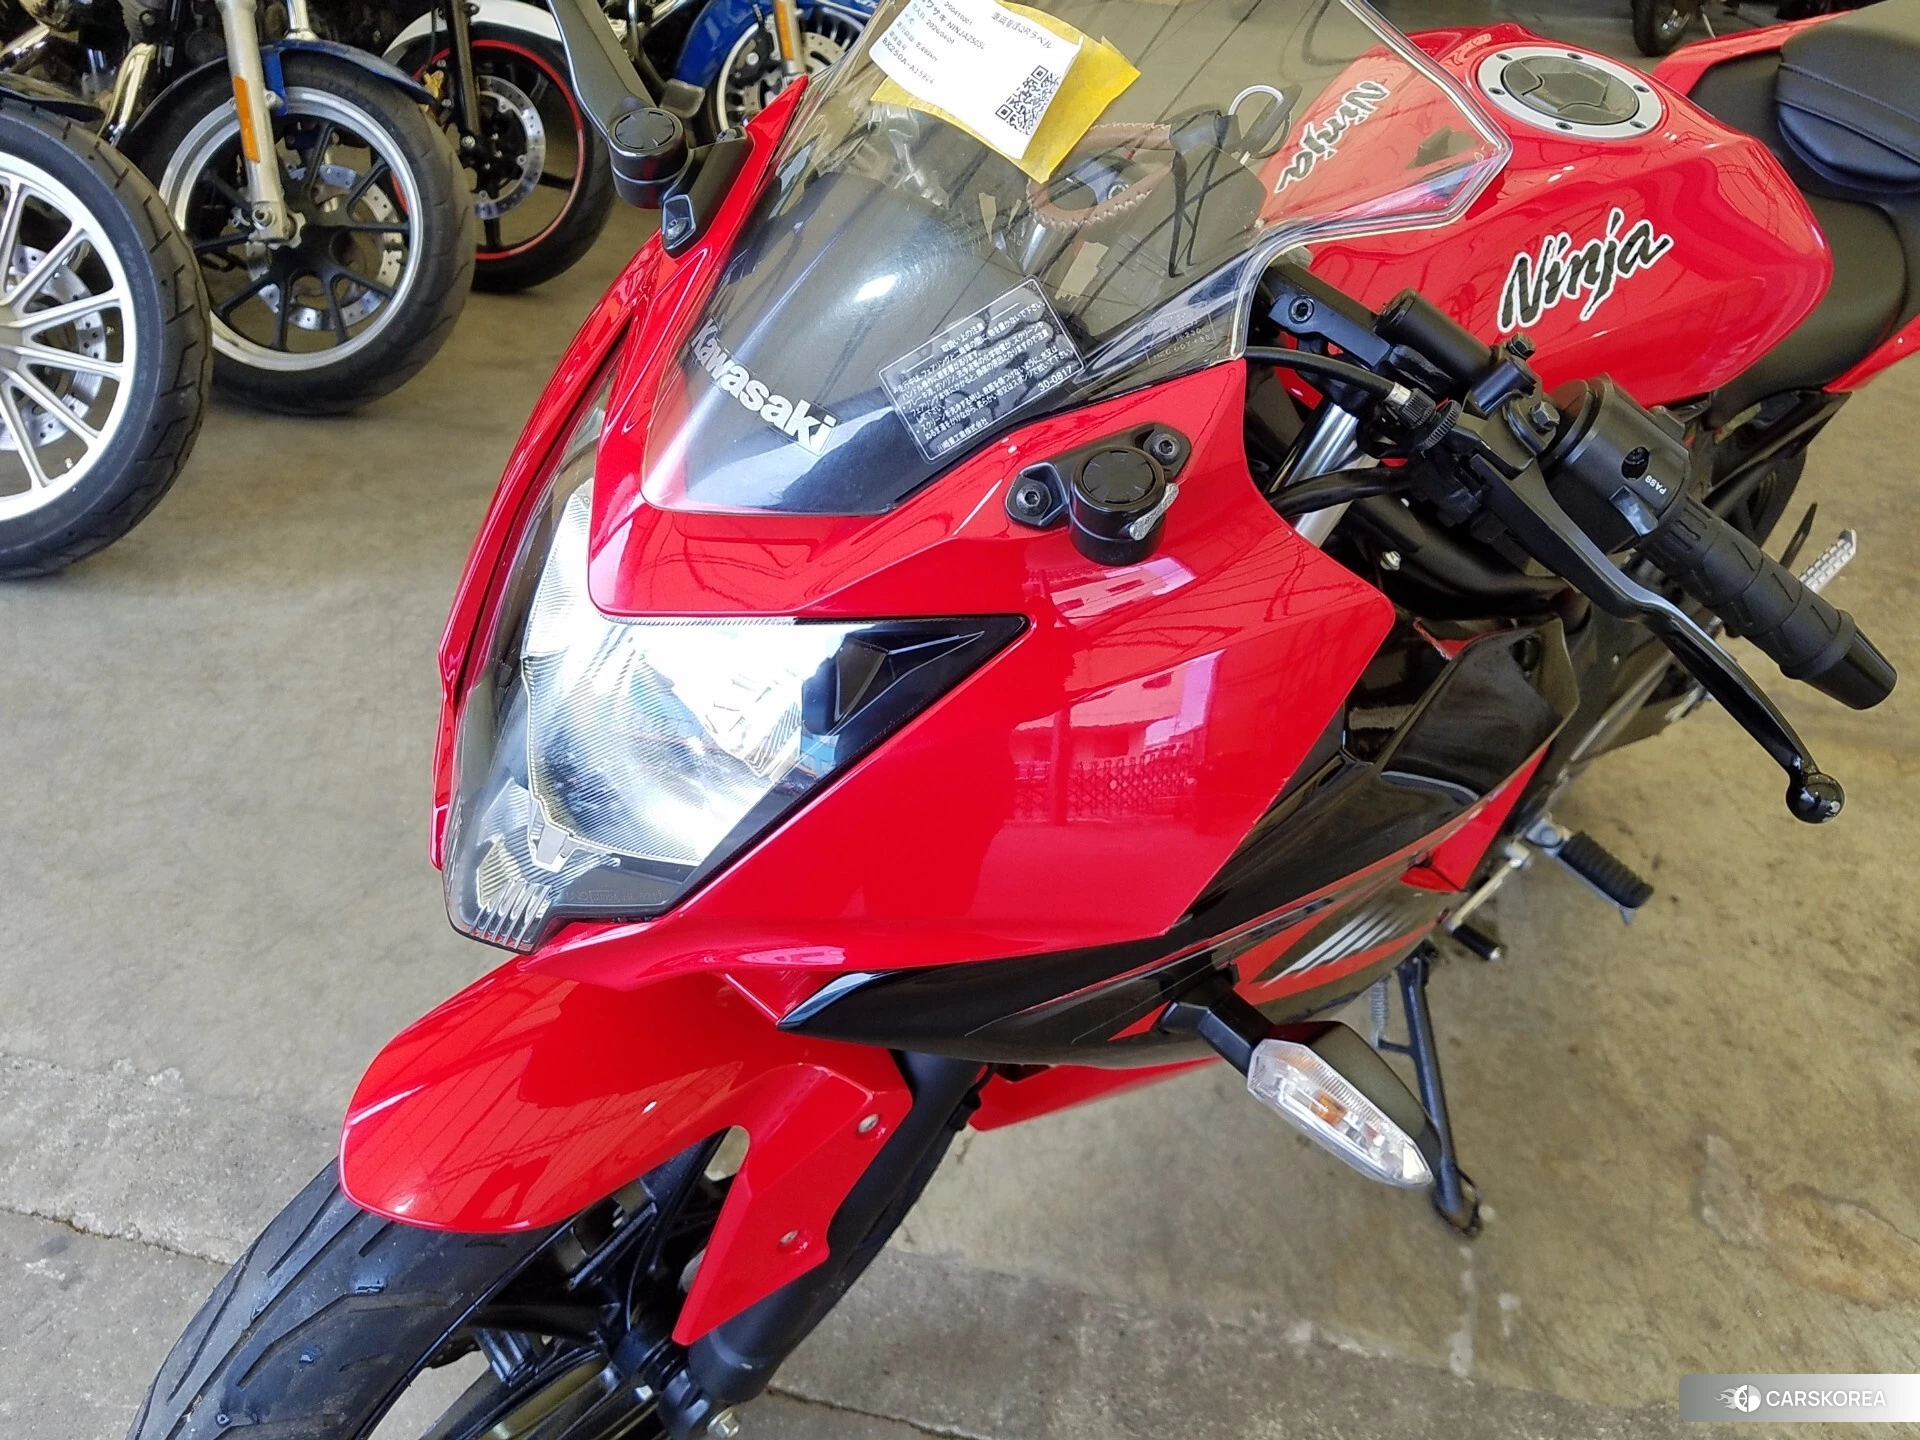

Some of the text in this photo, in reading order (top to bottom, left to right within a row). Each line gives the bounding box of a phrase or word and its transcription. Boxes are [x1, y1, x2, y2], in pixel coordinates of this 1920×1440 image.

[1273, 80, 1391, 194] Ninja
[1497, 207, 1675, 333] Ninja
[690, 317, 837, 452] Kawasaki
[1037, 365, 1073, 392] 30-0817
